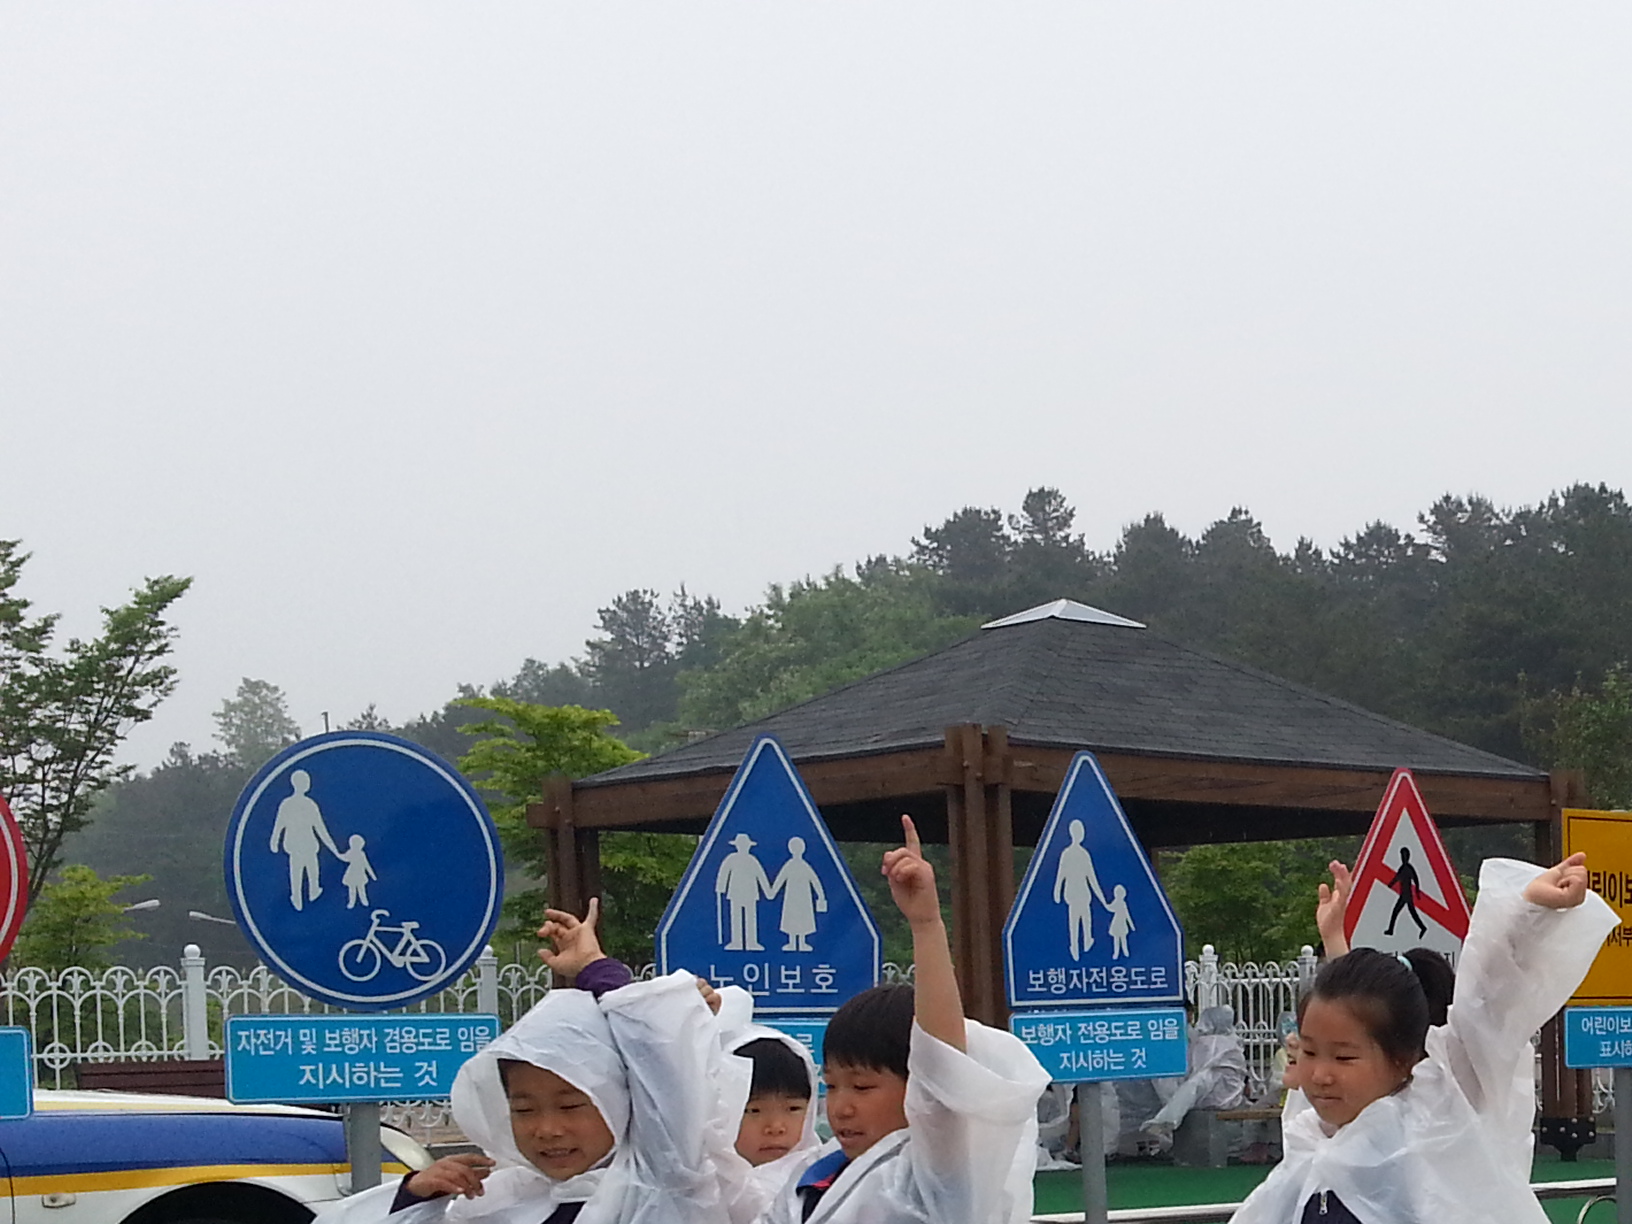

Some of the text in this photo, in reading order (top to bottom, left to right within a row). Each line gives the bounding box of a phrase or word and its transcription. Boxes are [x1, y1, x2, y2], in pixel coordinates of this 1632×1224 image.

[1027, 966, 1168, 995] 보행자전용도로
[237, 1025, 491, 1056] 자전거 및 보행자 겸용도로 임을
[1021, 1018, 1180, 1046] 보행자 전용도로 임을
[298, 1060, 438, 1089] 지시하는 것
[1059, 1048, 1148, 1072] 지시하는 것
